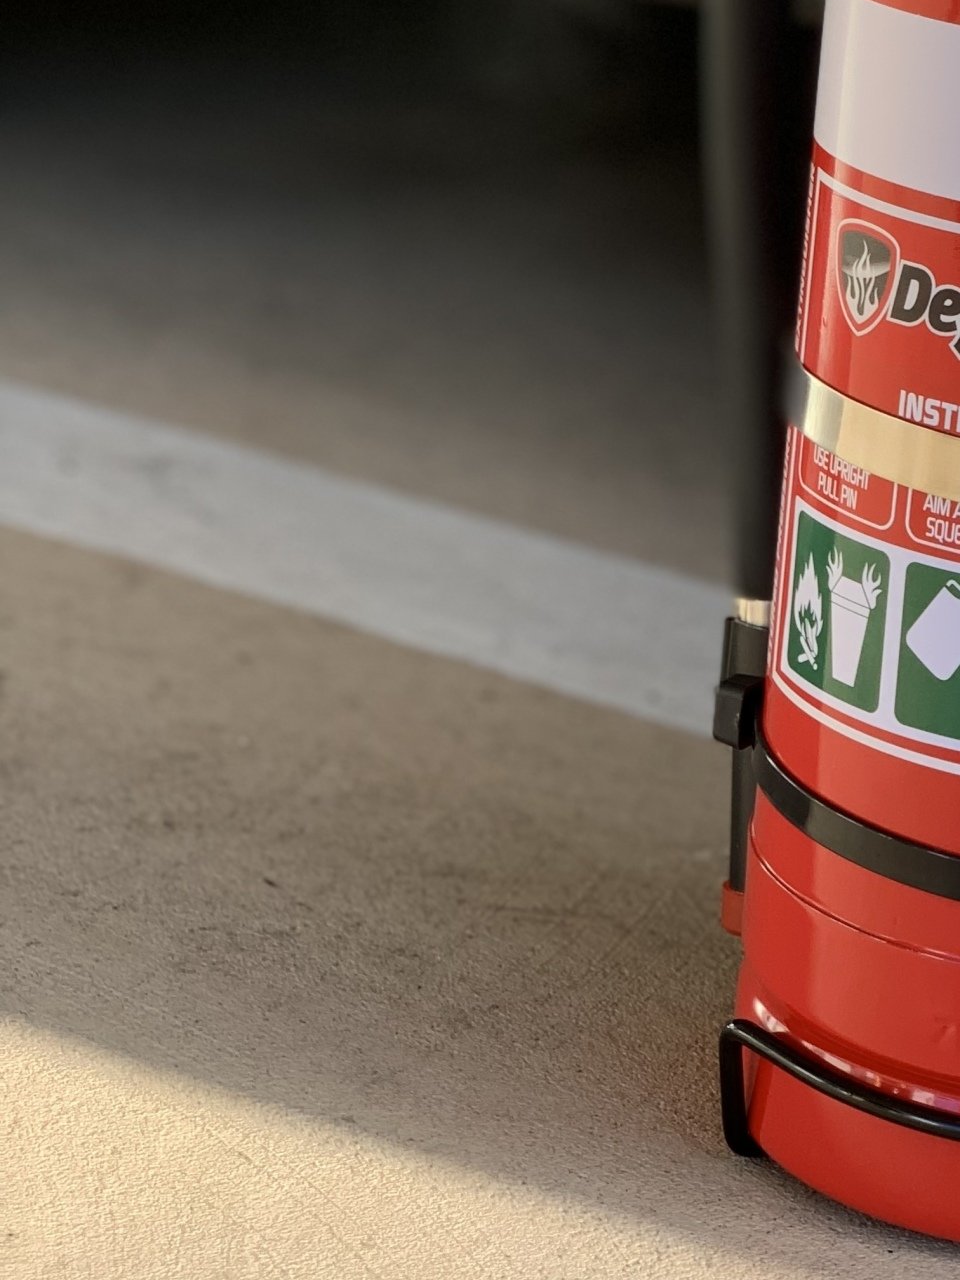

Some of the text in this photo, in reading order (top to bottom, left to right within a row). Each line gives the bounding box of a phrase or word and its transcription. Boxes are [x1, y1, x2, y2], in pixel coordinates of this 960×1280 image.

[818, 471, 858, 510] PULL PIN
[829, 453, 871, 491] UPRIGHT
[923, 494, 951, 516] AIM
